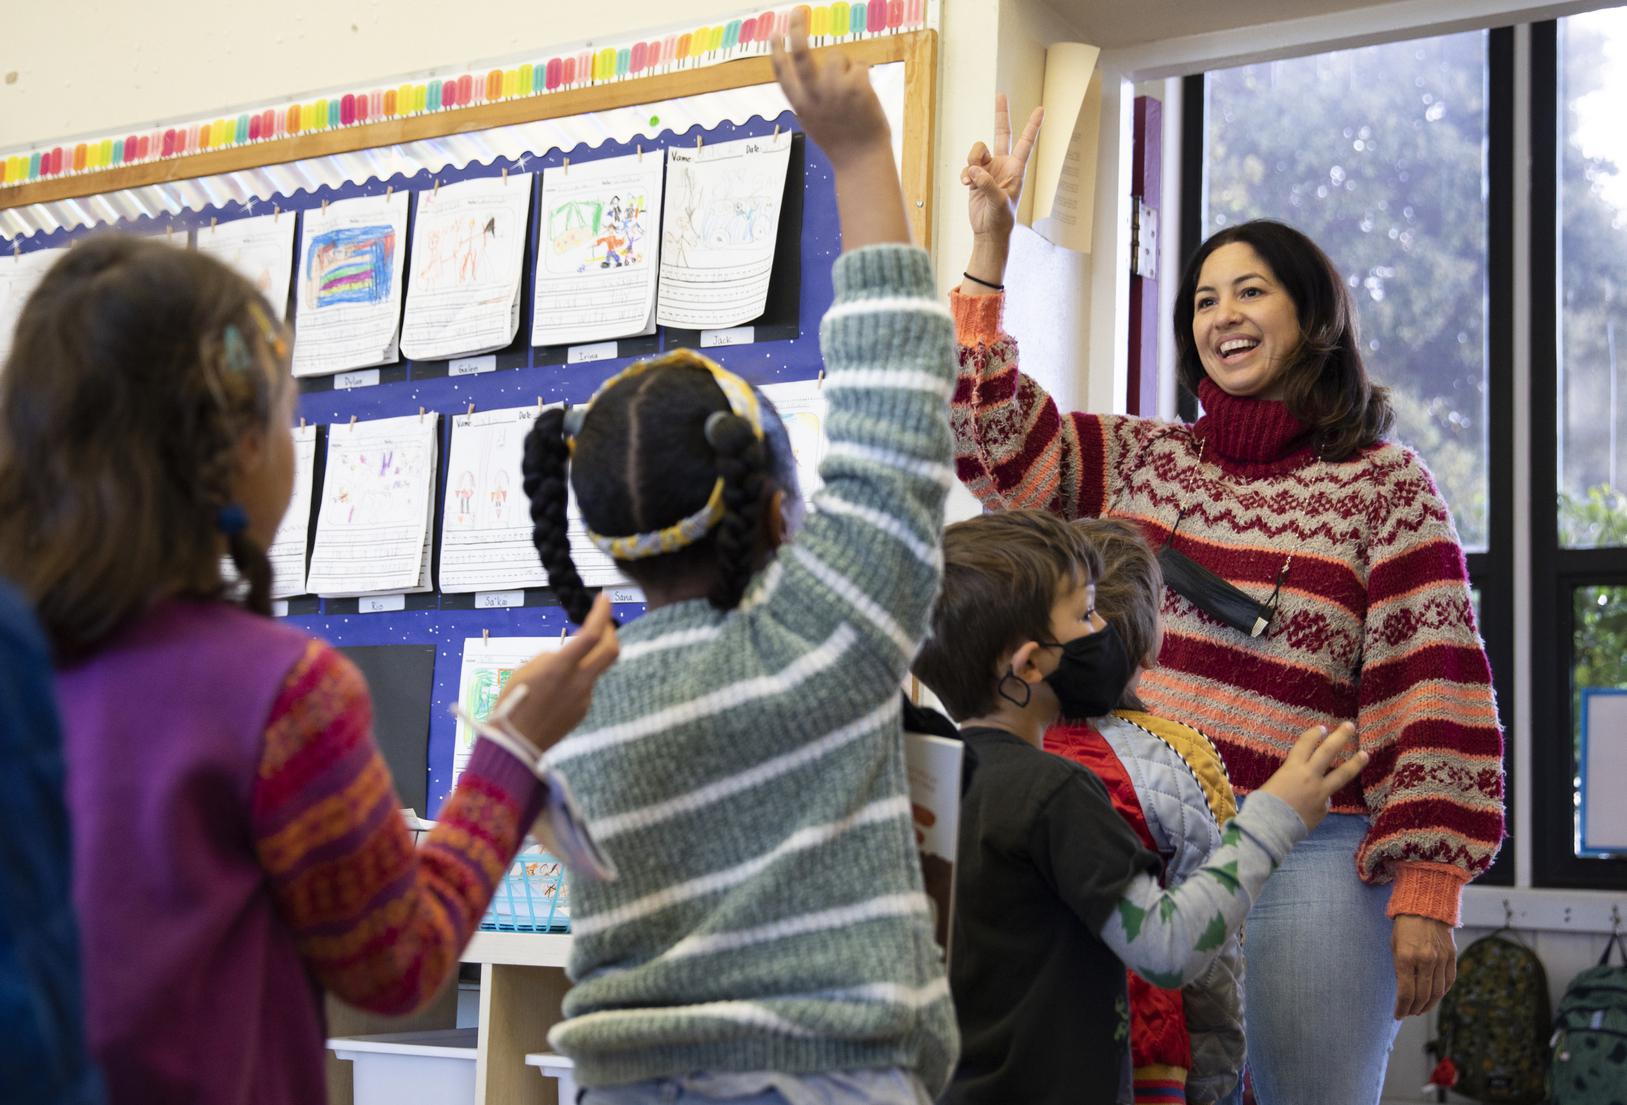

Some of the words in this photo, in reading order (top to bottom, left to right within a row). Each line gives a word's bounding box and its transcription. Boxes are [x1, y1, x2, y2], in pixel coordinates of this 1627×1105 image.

[746, 144, 760, 154] Date
[713, 335, 733, 345] Jack
[615, 590, 632, 601] Sana
